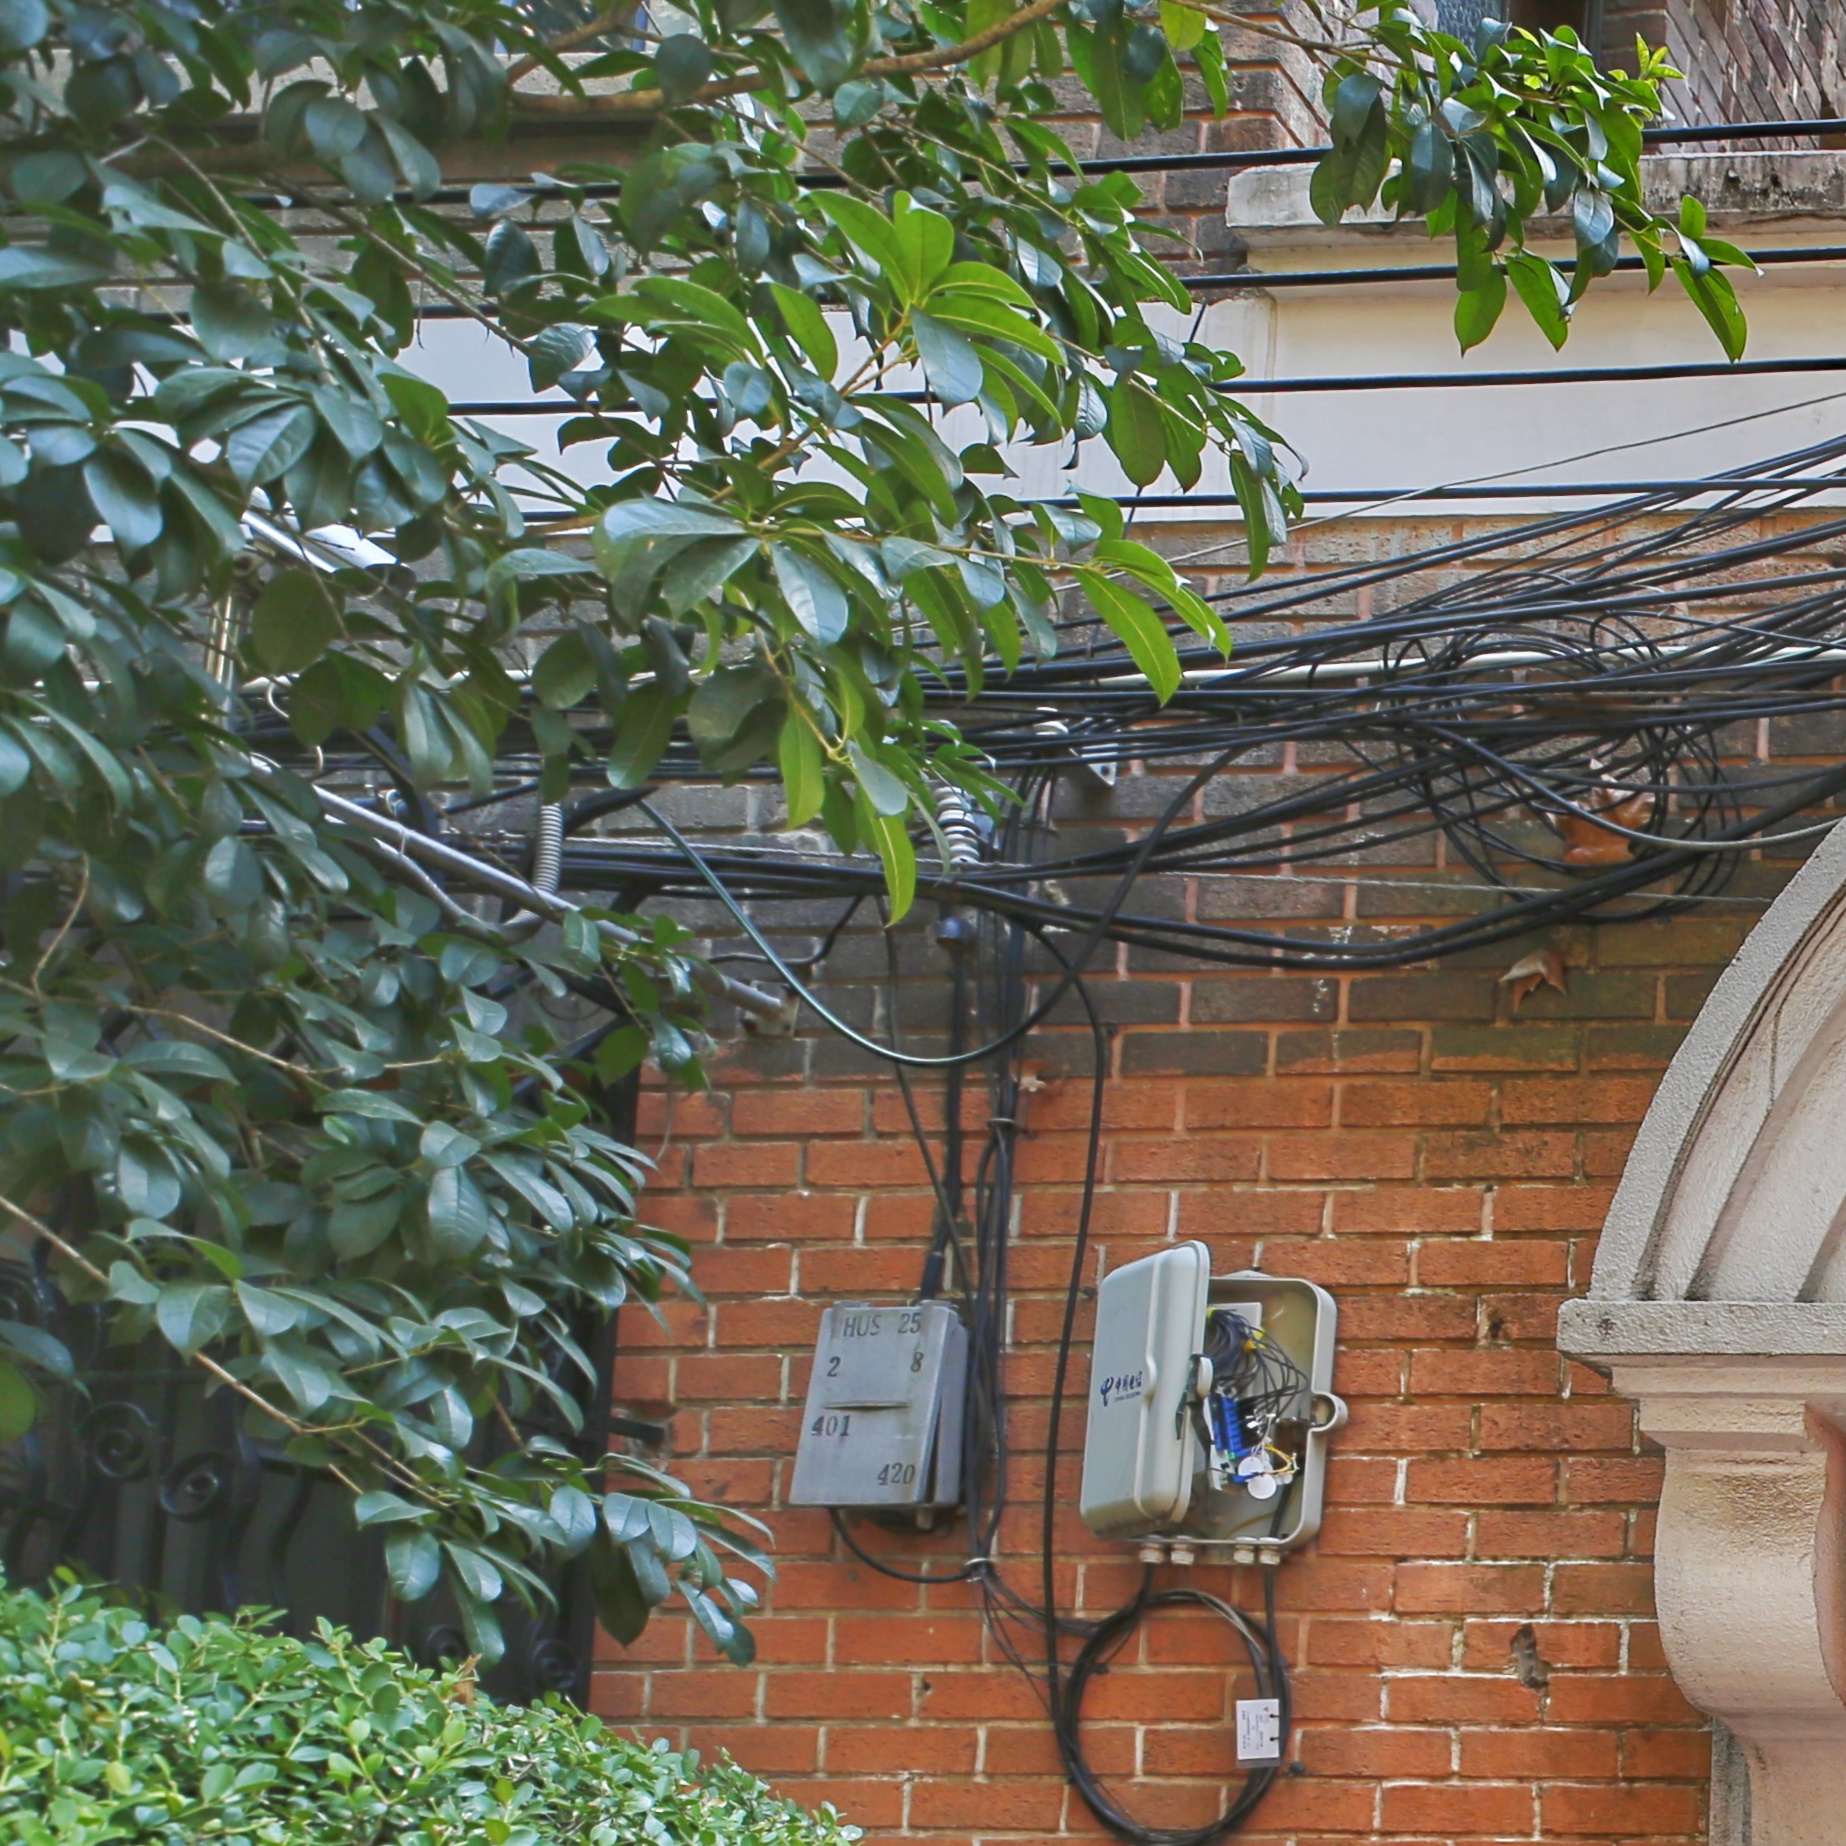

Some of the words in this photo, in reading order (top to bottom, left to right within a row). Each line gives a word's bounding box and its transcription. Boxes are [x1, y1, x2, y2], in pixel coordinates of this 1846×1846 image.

[897, 1312, 921, 1334] 25
[827, 1357, 841, 1377] 2
[910, 1351, 924, 1372] 8
[811, 1415, 850, 1437] 401
[877, 1463, 916, 1486] 420
